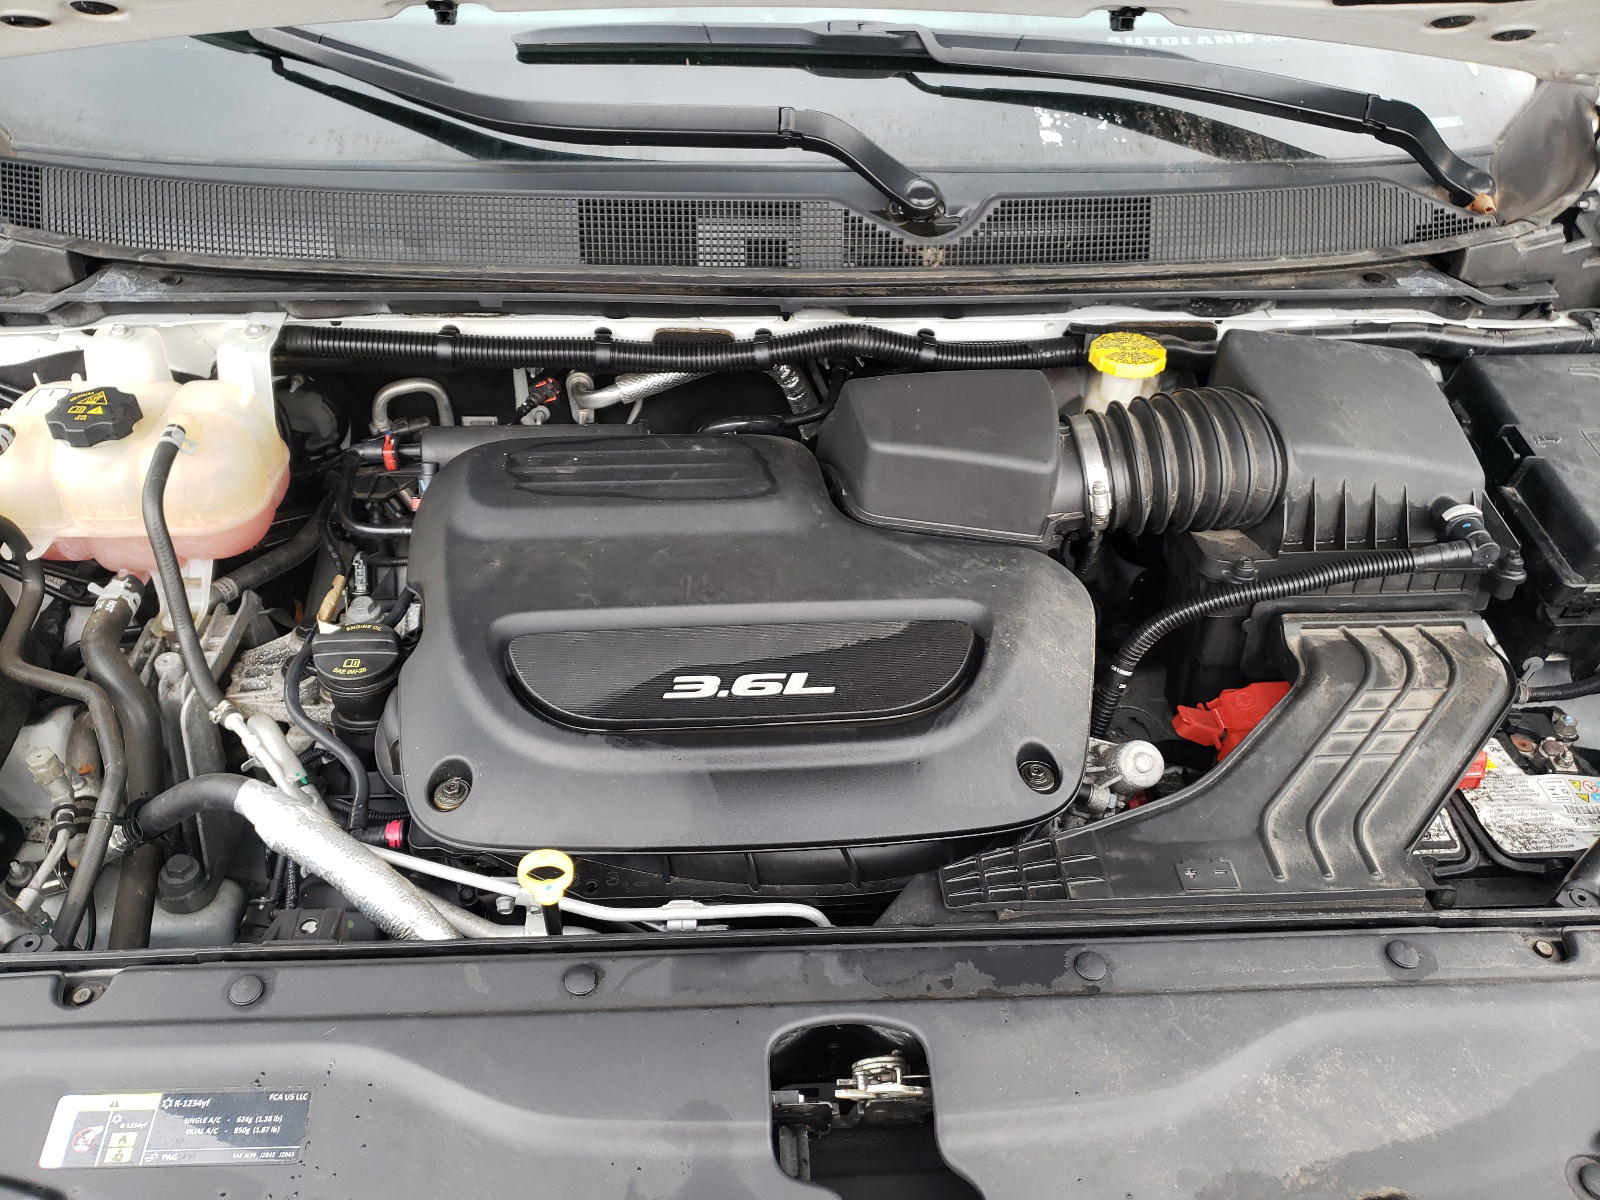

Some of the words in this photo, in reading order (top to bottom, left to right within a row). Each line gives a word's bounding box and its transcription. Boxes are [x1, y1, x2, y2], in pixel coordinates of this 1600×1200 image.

[1107, 34, 1254, 46] AUTOLAND
[662, 672, 836, 699] 3.6L
[268, 1093, 283, 1101] FCA
[284, 1093, 296, 1101] US
[296, 1092, 309, 1101] LLC
[173, 1098, 211, 1109] R-1234yf
[184, 1116, 207, 1125] SINGLE
[208, 1115, 222, 1125] A/C
[186, 1127, 204, 1136] DUAL
[204, 1126, 220, 1136] A/C
[161, 1153, 178, 1161] PAG
